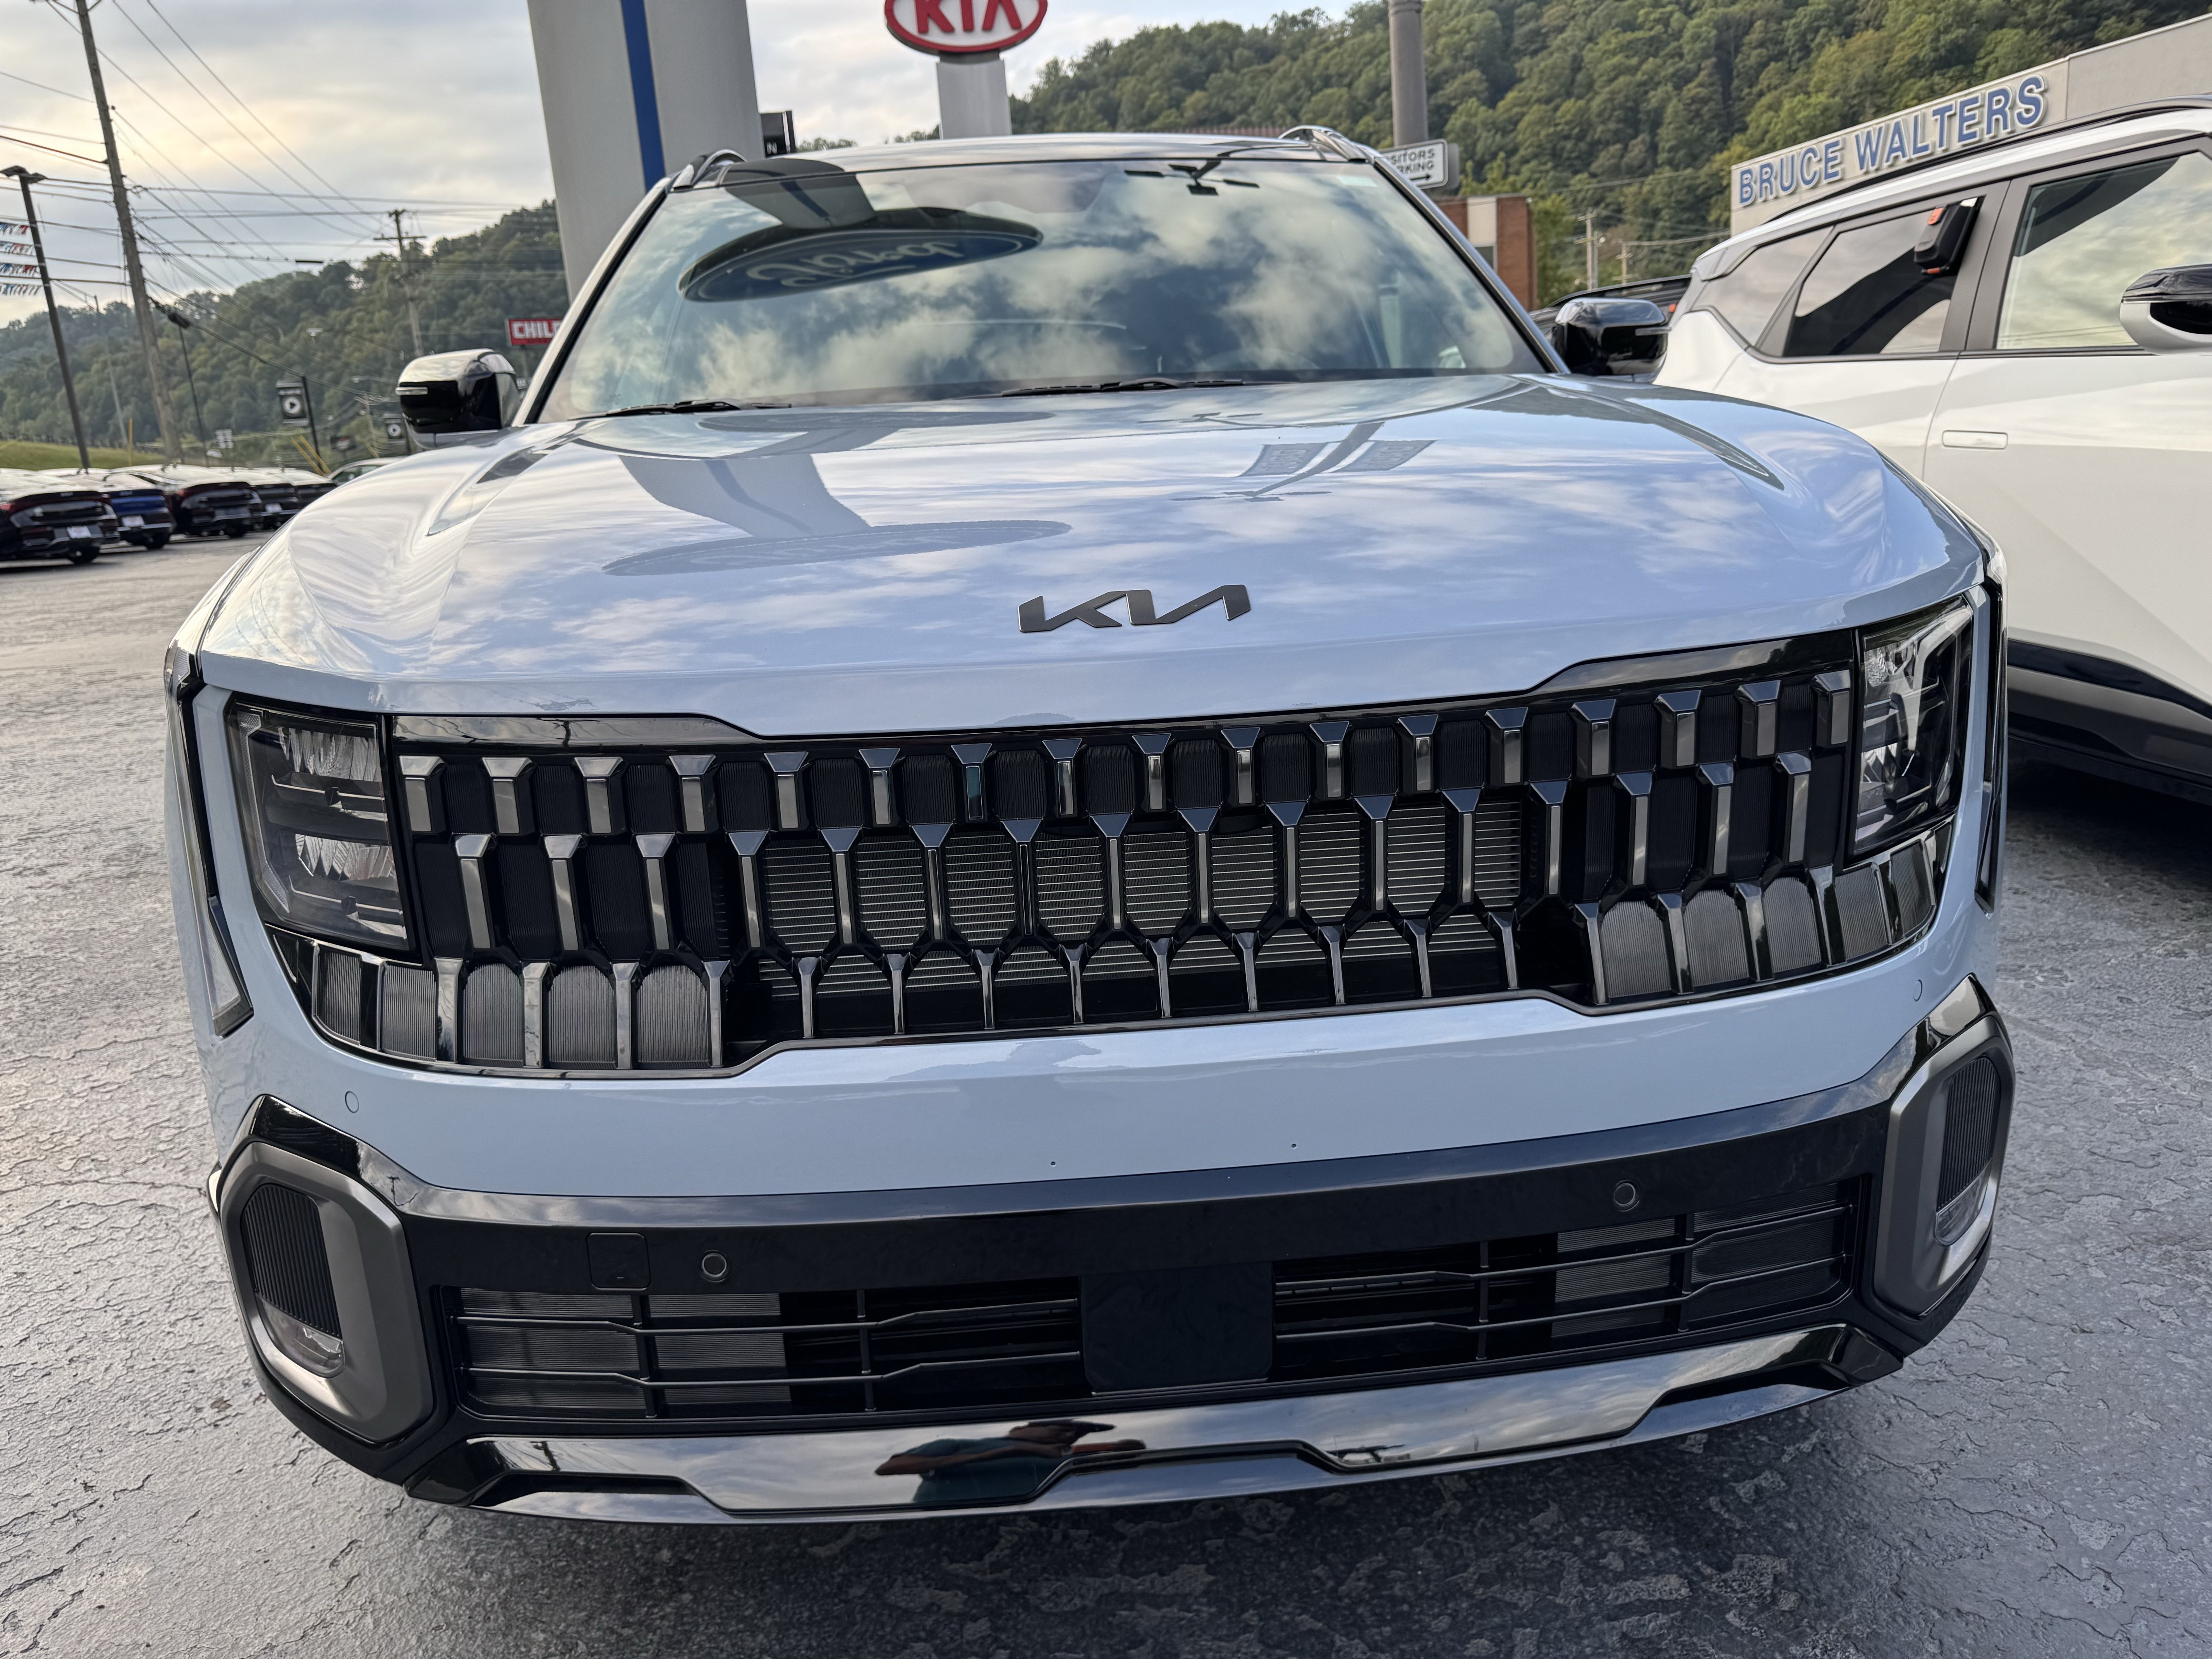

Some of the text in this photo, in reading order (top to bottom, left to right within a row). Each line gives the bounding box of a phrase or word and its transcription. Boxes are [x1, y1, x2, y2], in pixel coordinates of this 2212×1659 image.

[915, 0, 1022, 34] KIA
[1738, 74, 2046, 206] BRUCE WALTERS
